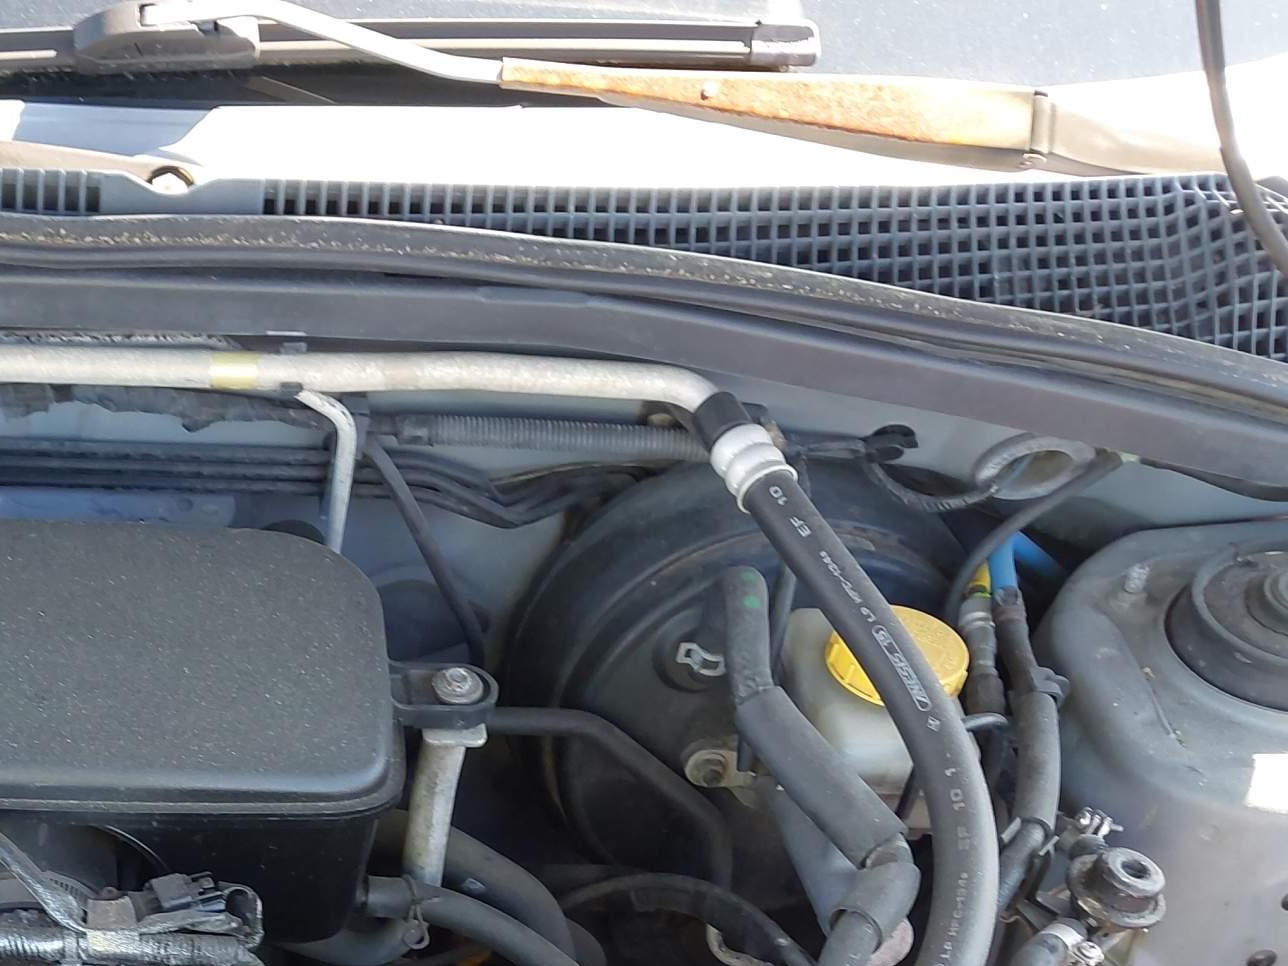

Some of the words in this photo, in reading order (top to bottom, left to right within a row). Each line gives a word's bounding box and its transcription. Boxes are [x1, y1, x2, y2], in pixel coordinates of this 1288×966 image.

[769, 485, 787, 506] 10
[789, 516, 812, 537] EF
[949, 788, 966, 811] 10
